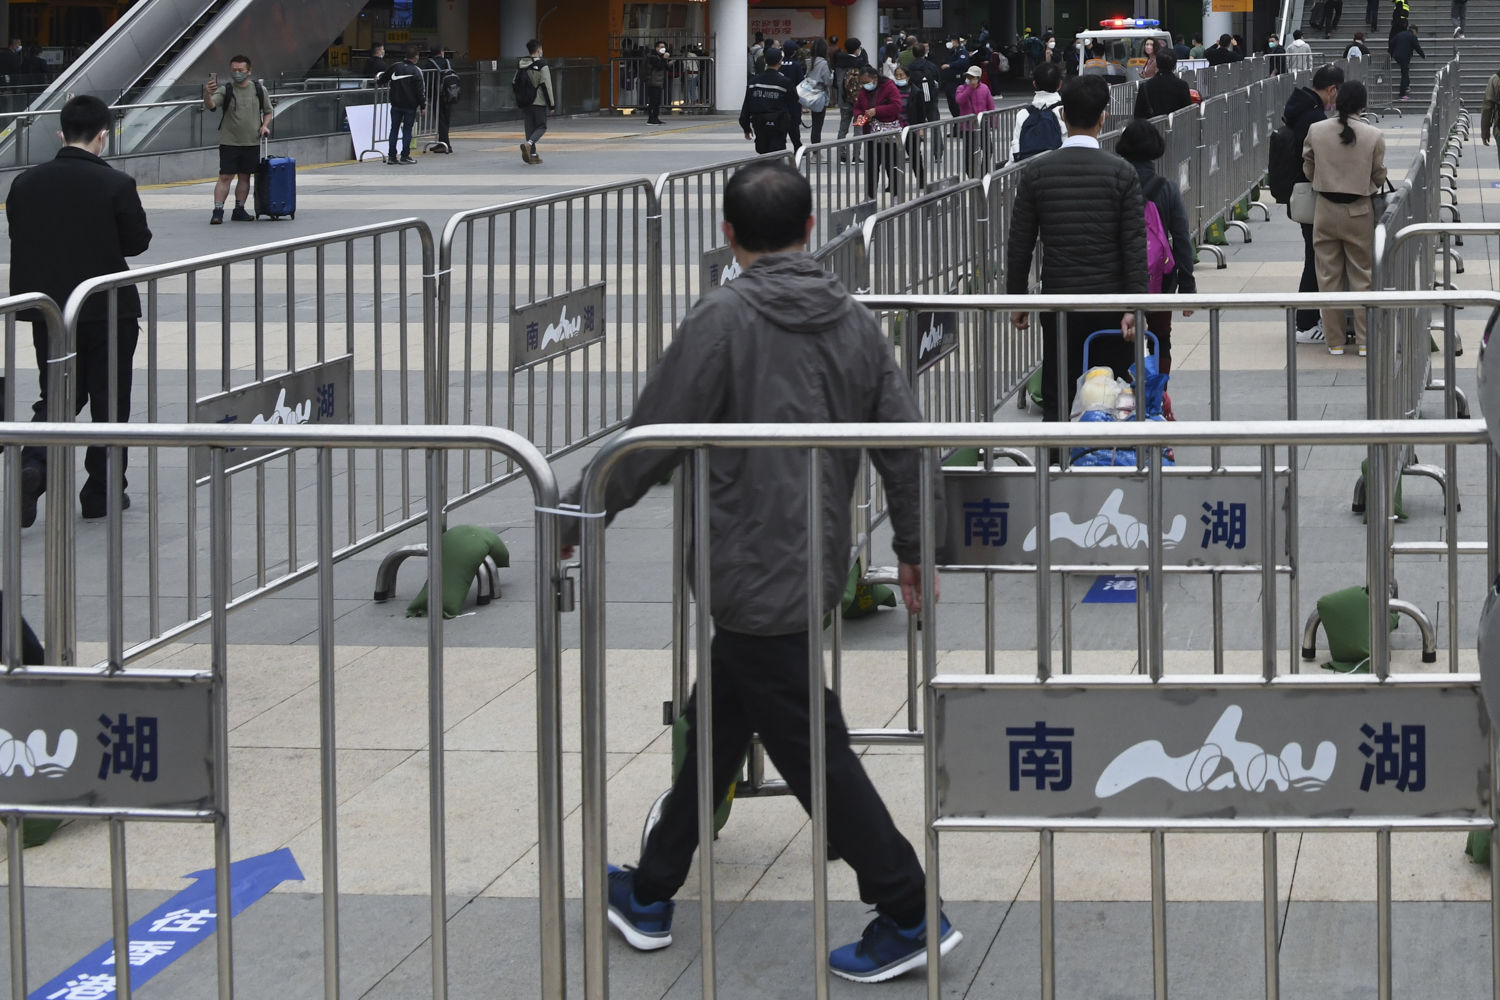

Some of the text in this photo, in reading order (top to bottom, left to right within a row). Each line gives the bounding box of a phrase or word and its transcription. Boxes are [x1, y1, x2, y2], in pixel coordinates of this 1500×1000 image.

[525, 320, 539, 351] 南
[316, 383, 335, 421] 湖
[963, 498, 1010, 547] 南
[1200, 501, 1247, 550] 湖
[97, 713, 158, 782] 湖
[1005, 721, 1075, 792] 南
[1357, 721, 1427, 793] 湖
[46, 908, 218, 1000] 往香港
